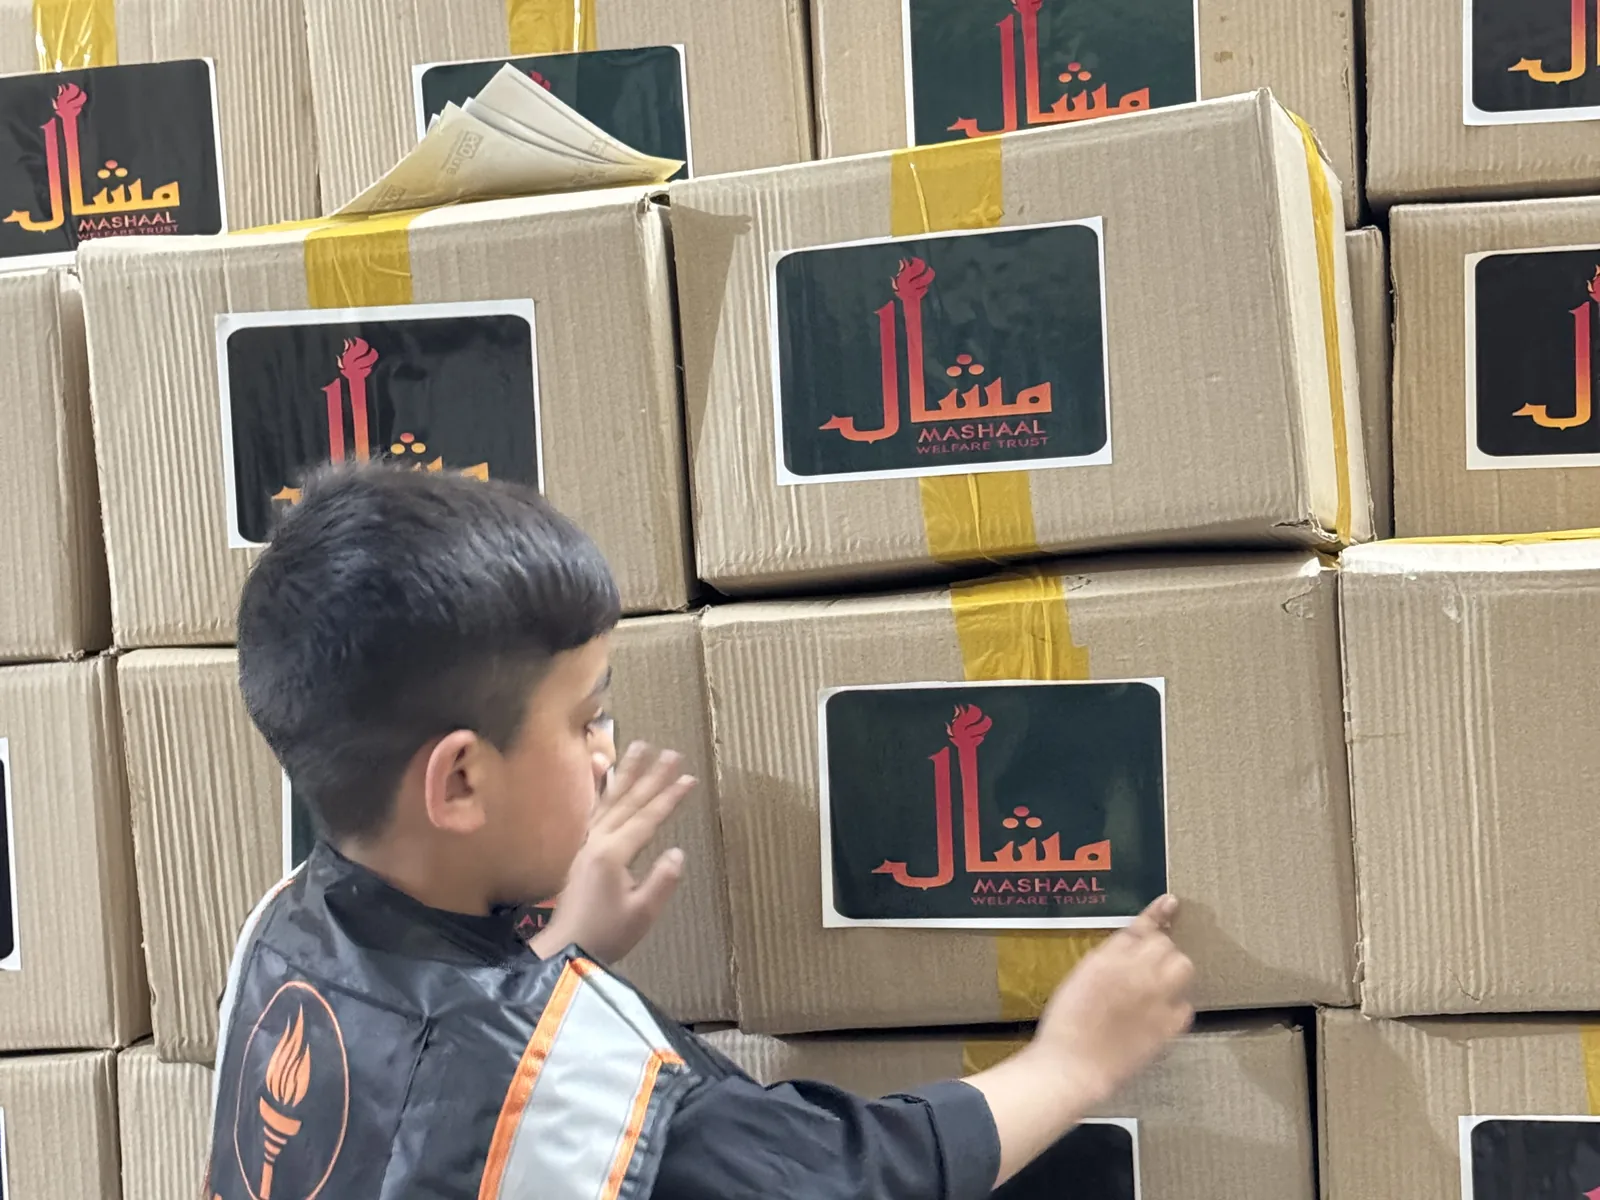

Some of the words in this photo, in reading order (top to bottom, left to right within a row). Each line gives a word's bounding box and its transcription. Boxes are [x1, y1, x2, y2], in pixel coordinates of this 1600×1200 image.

[78, 211, 177, 232] MASHAAL
[140, 224, 179, 235] TRUST
[918, 419, 1047, 444] MASHAAL
[916, 441, 992, 455] WELFARE
[996, 436, 1050, 450] TRUST
[972, 876, 1106, 894] MASHAAL
[970, 895, 1048, 906] WELFARE
[1052, 893, 1108, 905] TRUST
